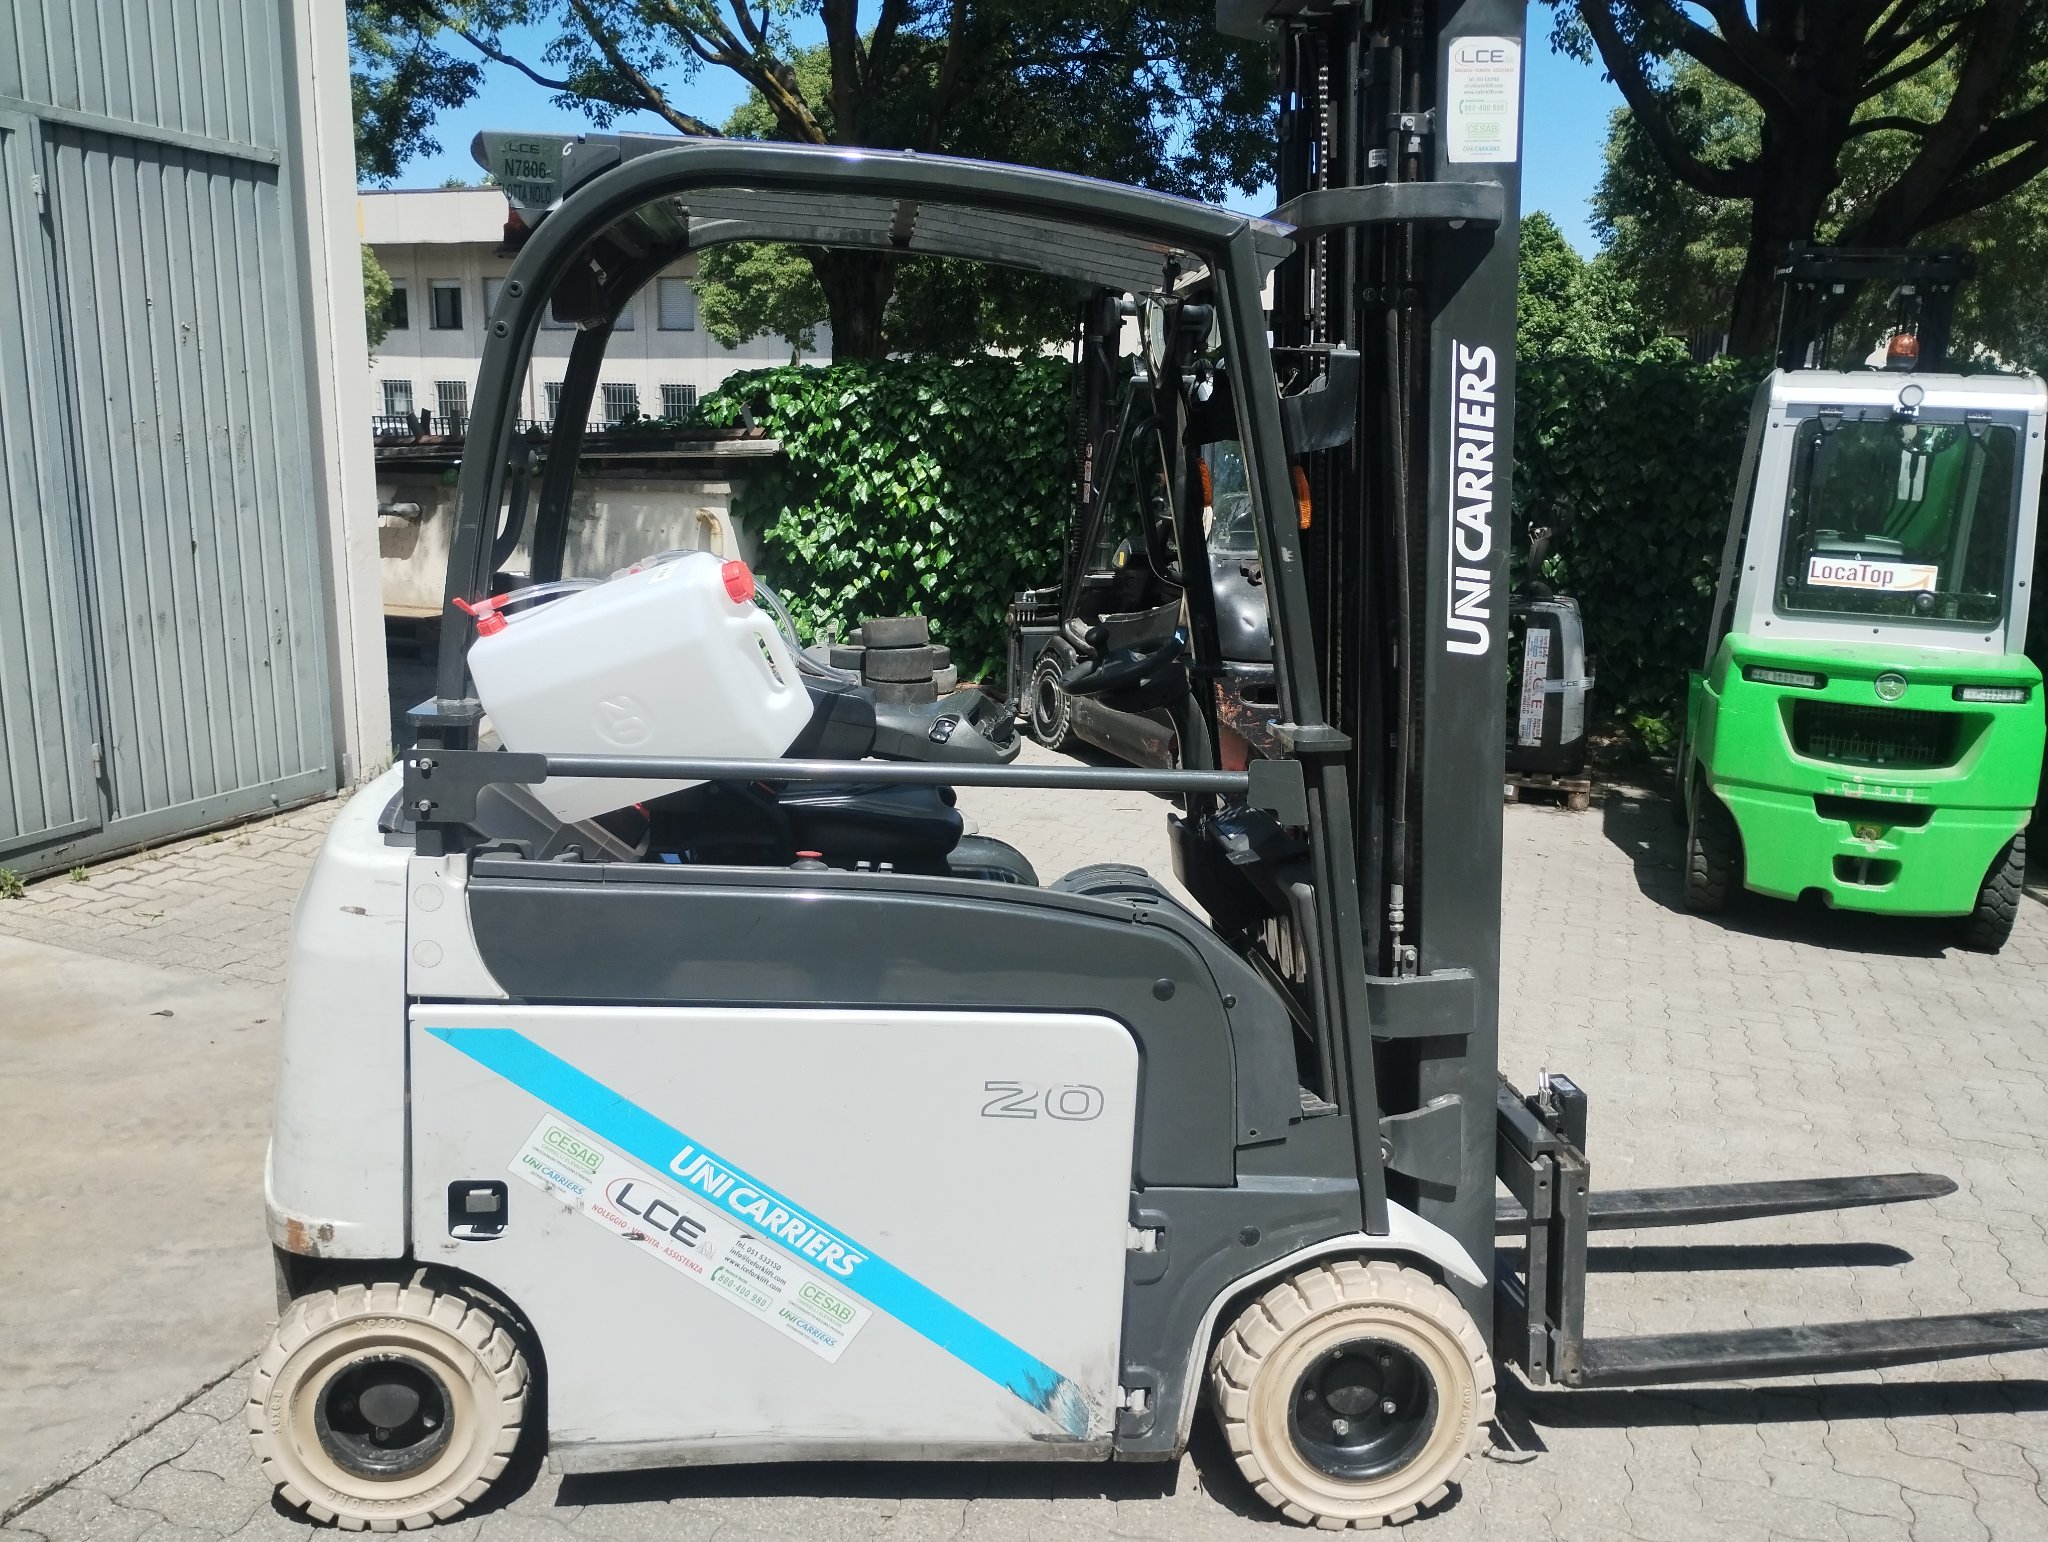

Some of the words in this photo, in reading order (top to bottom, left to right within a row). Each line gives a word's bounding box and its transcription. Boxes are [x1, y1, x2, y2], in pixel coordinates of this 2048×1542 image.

[1461, 49, 1505, 63] LCE
[504, 158, 547, 179] N7806
[529, 185, 552, 204] NOLO
[1810, 560, 1895, 586] LocaTop
[981, 1081, 1104, 1121] 20
[546, 1129, 600, 1167] CESAB
[615, 1182, 707, 1247] LCE
[591, 1203, 627, 1229] NOLEGGIO
[663, 1246, 703, 1274] ASSISTENZA
[724, 1253, 783, 1293] www.lceforklift.com
[746, 1246, 758, 1257] 051
[758, 1254, 781, 1271] 533150
[717, 1273, 751, 1297] 800-400
[750, 1293, 767, 1307] 980
[801, 1283, 852, 1321] CESAB
[355, 1318, 408, 1332] XP800
[1455, 1382, 1472, 1443] 200/50-10
